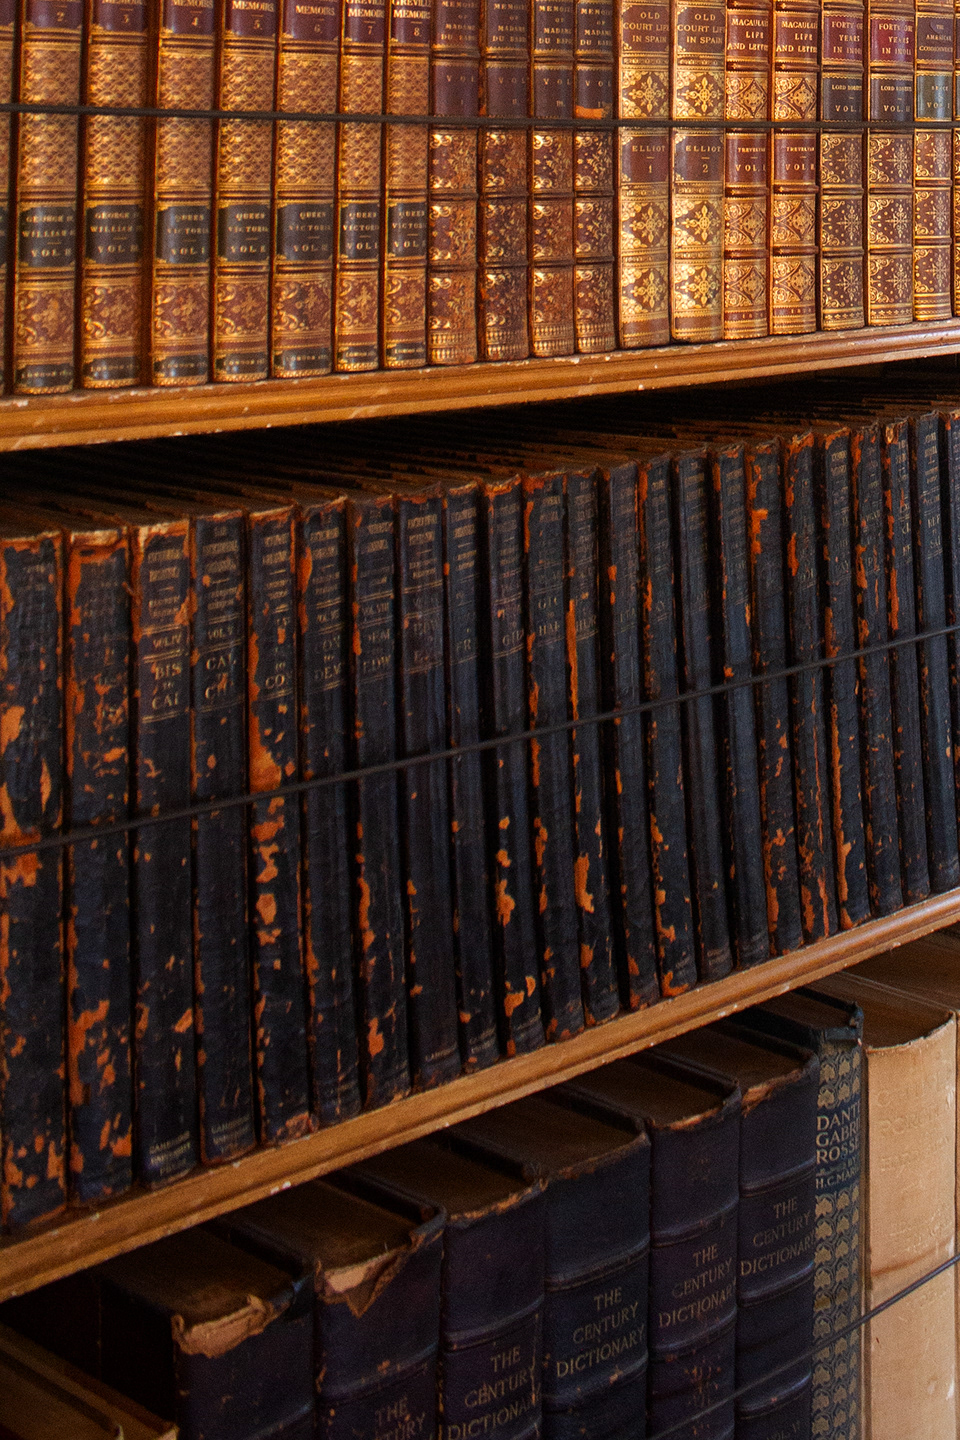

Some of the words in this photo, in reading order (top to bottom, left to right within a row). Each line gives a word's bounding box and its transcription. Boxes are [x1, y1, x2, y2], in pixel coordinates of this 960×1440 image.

[232, 1, 274, 11] MEMOIRS
[295, 5, 336, 16] MEMOIRS
[622, 23, 653, 31] COURT
[677, 24, 709, 32] COURT
[632, 35, 642, 43] IN
[745, 31, 764, 39] LIFE
[794, 33, 813, 41] LIFE
[727, 42, 746, 51] AND
[776, 44, 794, 53] AND
[648, 164, 652, 173] 1
[702, 164, 708, 173] 2
[773, 1197, 798, 1219] THE
[753, 1211, 811, 1248] CENTURY
[692, 1243, 719, 1267] THE
[672, 1257, 733, 1299] CENTURY
[593, 1287, 623, 1311] THE
[572, 1301, 639, 1345] CENTURY
[556, 1324, 646, 1378] DICTIONARY
[490, 1346, 521, 1372] THE
